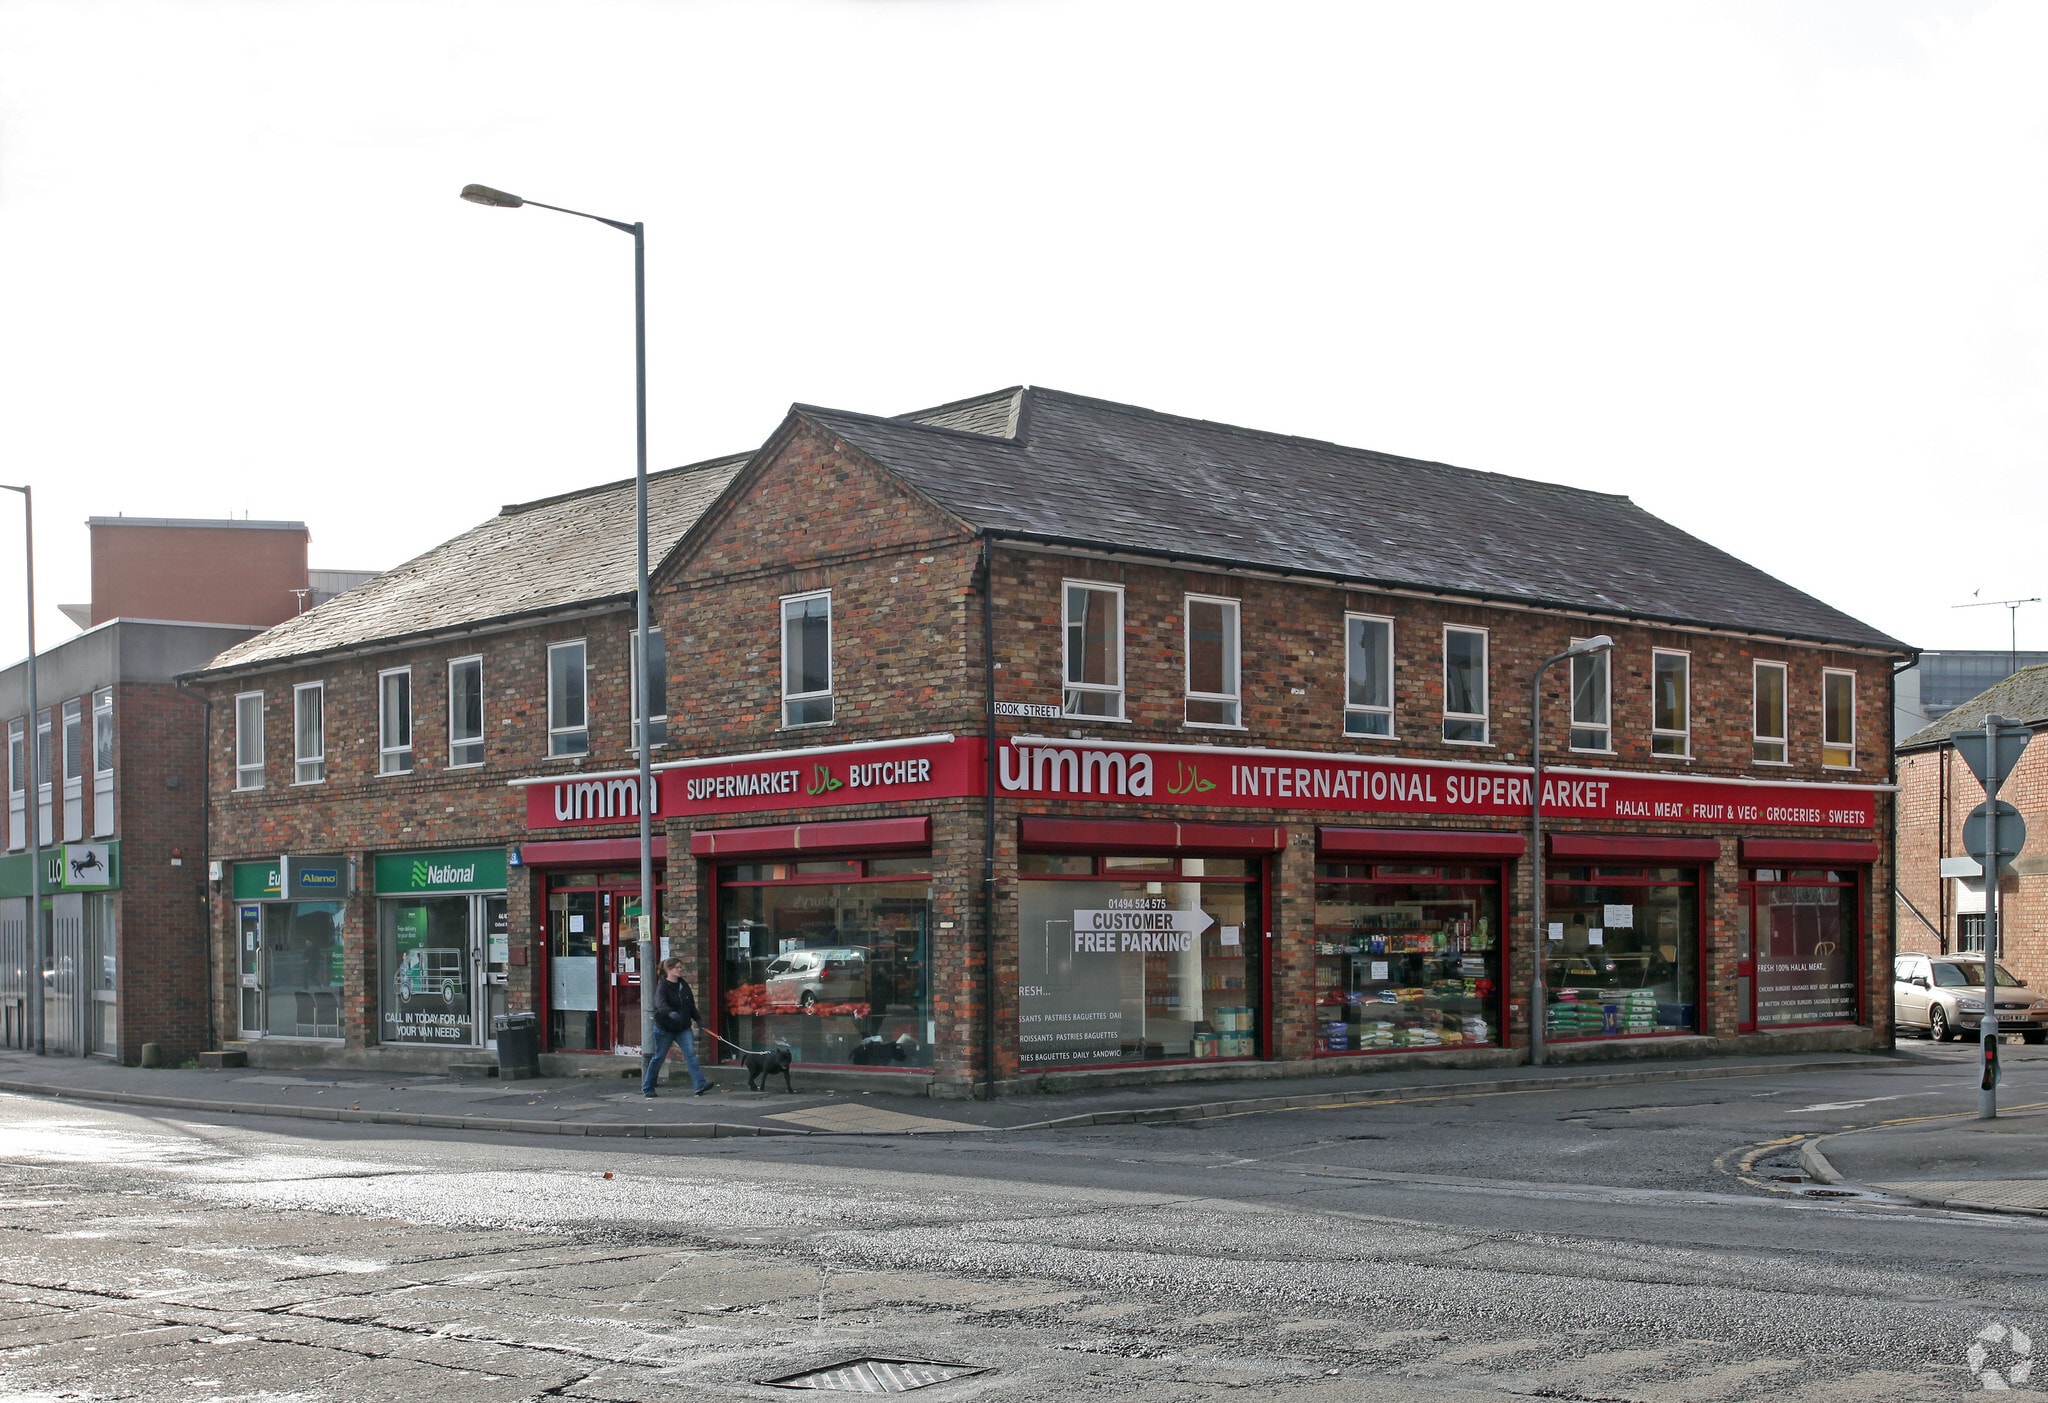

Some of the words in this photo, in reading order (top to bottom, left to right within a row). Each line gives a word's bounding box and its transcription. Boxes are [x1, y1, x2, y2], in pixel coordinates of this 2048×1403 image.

[994, 702, 1019, 716] ROOK
[1023, 704, 1057, 717] STREET
[849, 758, 931, 788] BUTCHER
[999, 746, 1153, 797] umma
[687, 770, 800, 801] SUPERMARKET
[1232, 765, 1437, 802] INTERNATIONAL
[1446, 775, 1610, 808] SUPERMARKET
[1615, 800, 1651, 816] HALAL
[1654, 802, 1683, 817] MEAT
[1693, 803, 1724, 819] FRUIT
[1727, 805, 1734, 820] &
[1737, 805, 1758, 820] VEG
[1766, 807, 1820, 823] GROCERIES
[1828, 809, 1865, 824] SWEETS
[48, 858, 63, 884] LLO
[268, 871, 281, 886] Eu
[302, 873, 336, 884] Alamo
[427, 863, 475, 884] National
[1108, 899, 1133, 909] 01494
[1135, 899, 1150, 909] 524
[1151, 899, 1167, 909] 575
[1092, 912, 1174, 930] CUSTOMER
[1074, 932, 1116, 953] FREE
[1121, 932, 1192, 953] PARKING
[1757, 964, 1775, 973] FRESH
[1775, 963, 1790, 972] 100%
[1790, 963, 1808, 972] HALAL
[385, 1012, 404, 1023] CALL
[405, 1013, 413, 1023] IN
[414, 1013, 439, 1024] TODAY
[440, 1014, 456, 1025] FOR
[457, 1014, 472, 1025] ALL
[1044, 1013, 1072, 1022] PASTRIES
[1072, 1012, 1107, 1021] BAGUETTES
[396, 1026, 417, 1036] YOUR
[419, 1026, 433, 1037] VAN
[435, 1027, 461, 1038] NEEDS
[1056, 1032, 1083, 1041] PASTRIES
[1084, 1031, 1118, 1040] BAGUETTES
[1035, 1052, 1070, 1061] BAGUETTES
[1072, 1051, 1090, 1059] DAILY
